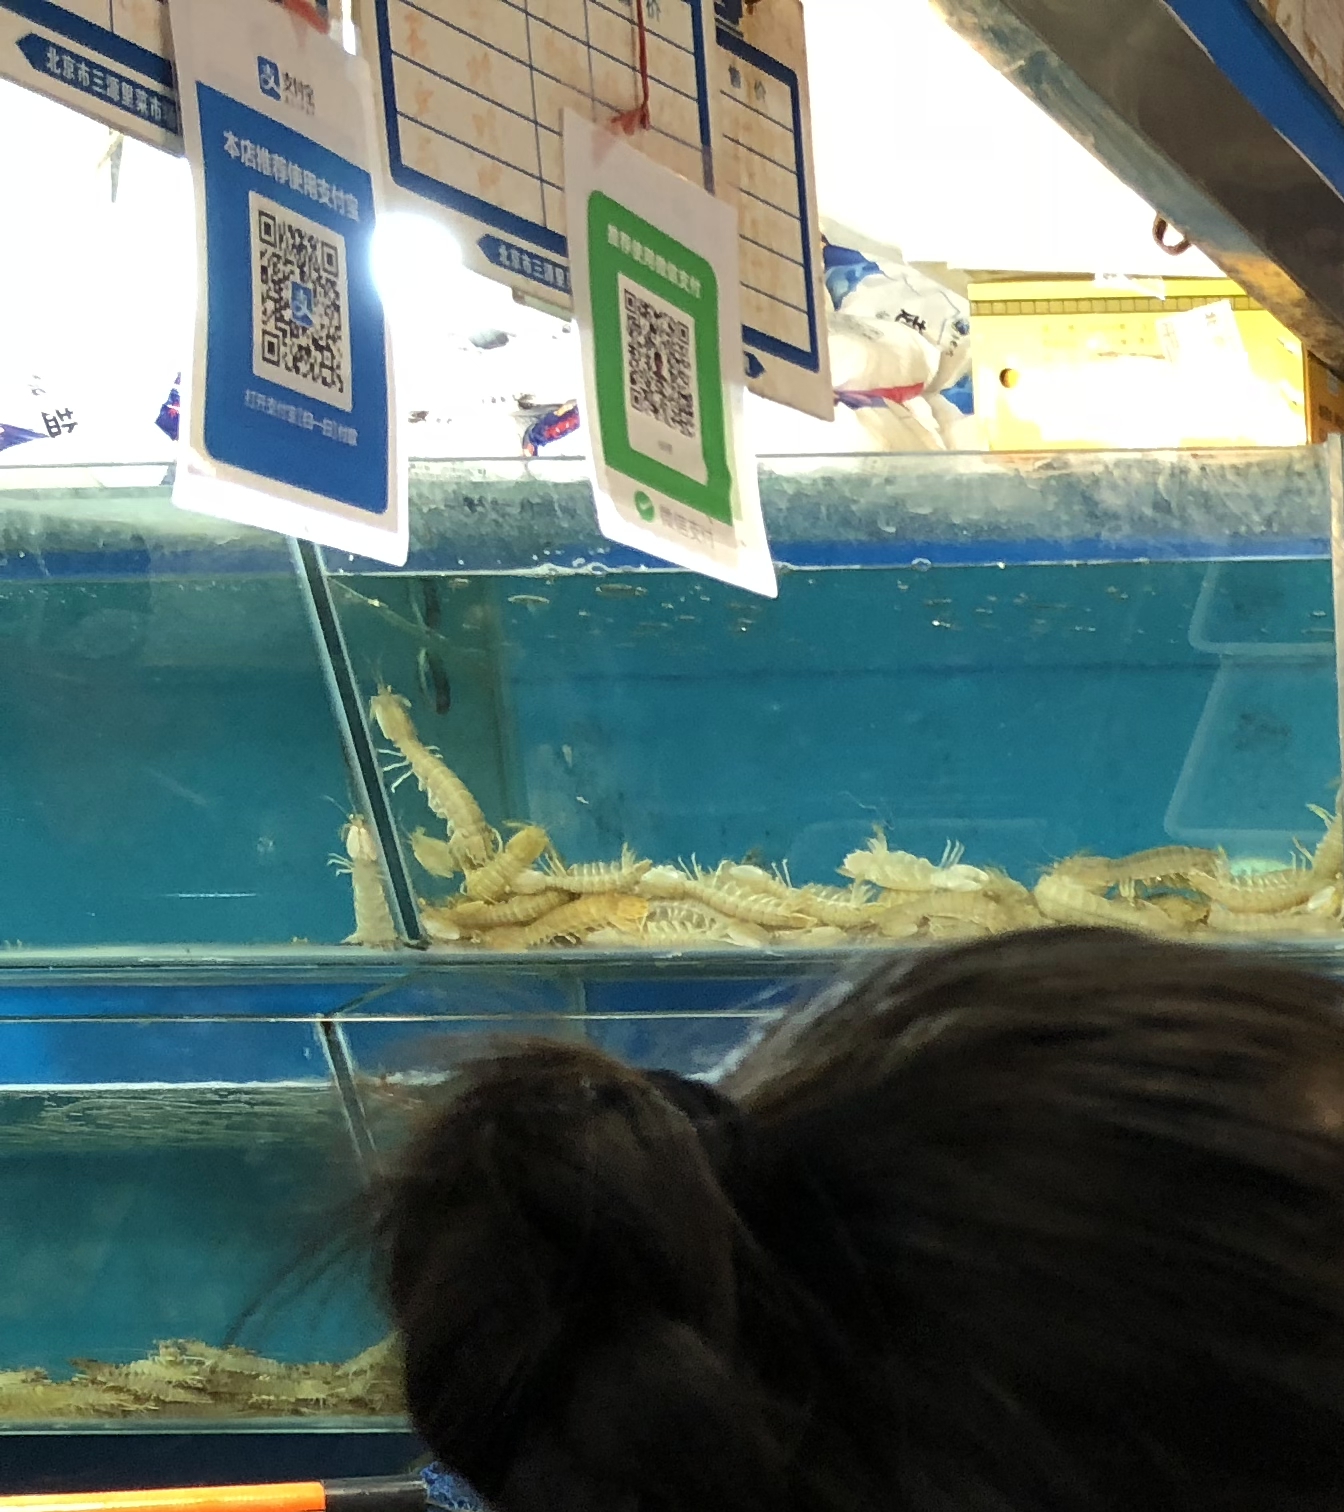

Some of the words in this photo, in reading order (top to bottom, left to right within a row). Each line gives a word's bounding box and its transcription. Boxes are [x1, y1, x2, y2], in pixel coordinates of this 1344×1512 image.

[223, 130, 360, 222] 本店推荐使用支付宝
